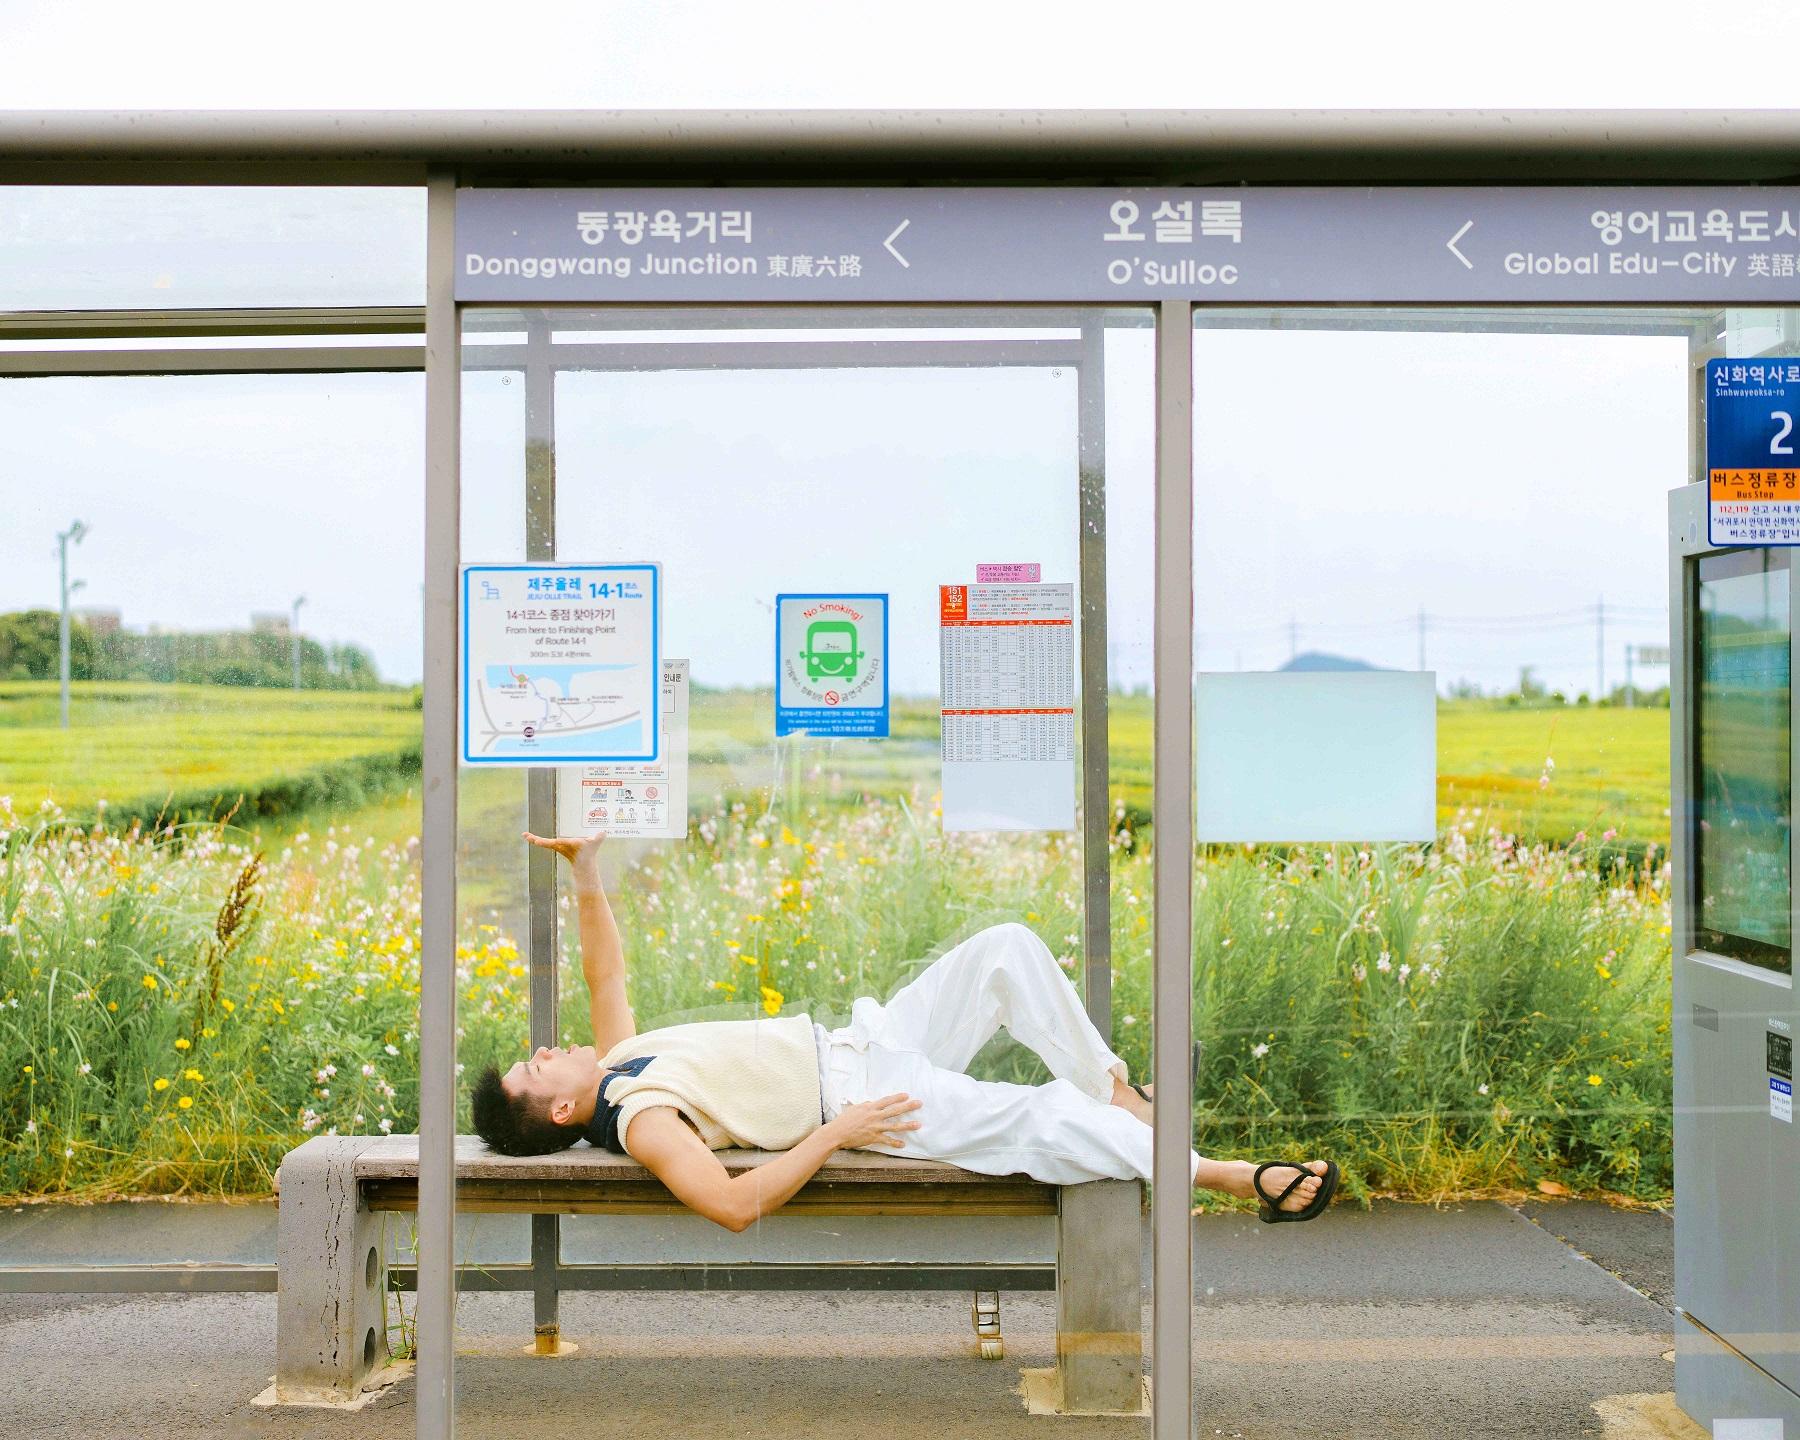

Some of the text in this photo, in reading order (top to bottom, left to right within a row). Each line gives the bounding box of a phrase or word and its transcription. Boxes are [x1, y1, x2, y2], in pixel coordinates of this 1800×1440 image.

[576, 209, 753, 244] 동광육거리
[1102, 199, 1244, 244] 오설록
[465, 251, 863, 279] Donggwang Junction 東廣六路
[1106, 256, 1240, 286] O'Sulloc
[1503, 250, 1800, 279] Global Edu-City 英語
[1715, 388, 1785, 398] Sinhwayeoksa-ro
[1769, 410, 1794, 455] 2
[1713, 472, 1798, 489] 버스정류장
[1736, 490, 1775, 500] Bus Stop
[1719, 505, 1749, 515] 112,119
[1752, 505, 1769, 516] 신고
[527, 576, 582, 592] 제주올레
[588, 582, 623, 599] 14-1
[948, 586, 961, 595] 151
[948, 594, 963, 603] 152
[506, 608, 616, 622] 14-1코스 종점 찾아가기
[803, 602, 864, 622] No Smoking!
[505, 625, 617, 636] From here to Finishing Point
[535, 637, 587, 646] of Route 14-1
